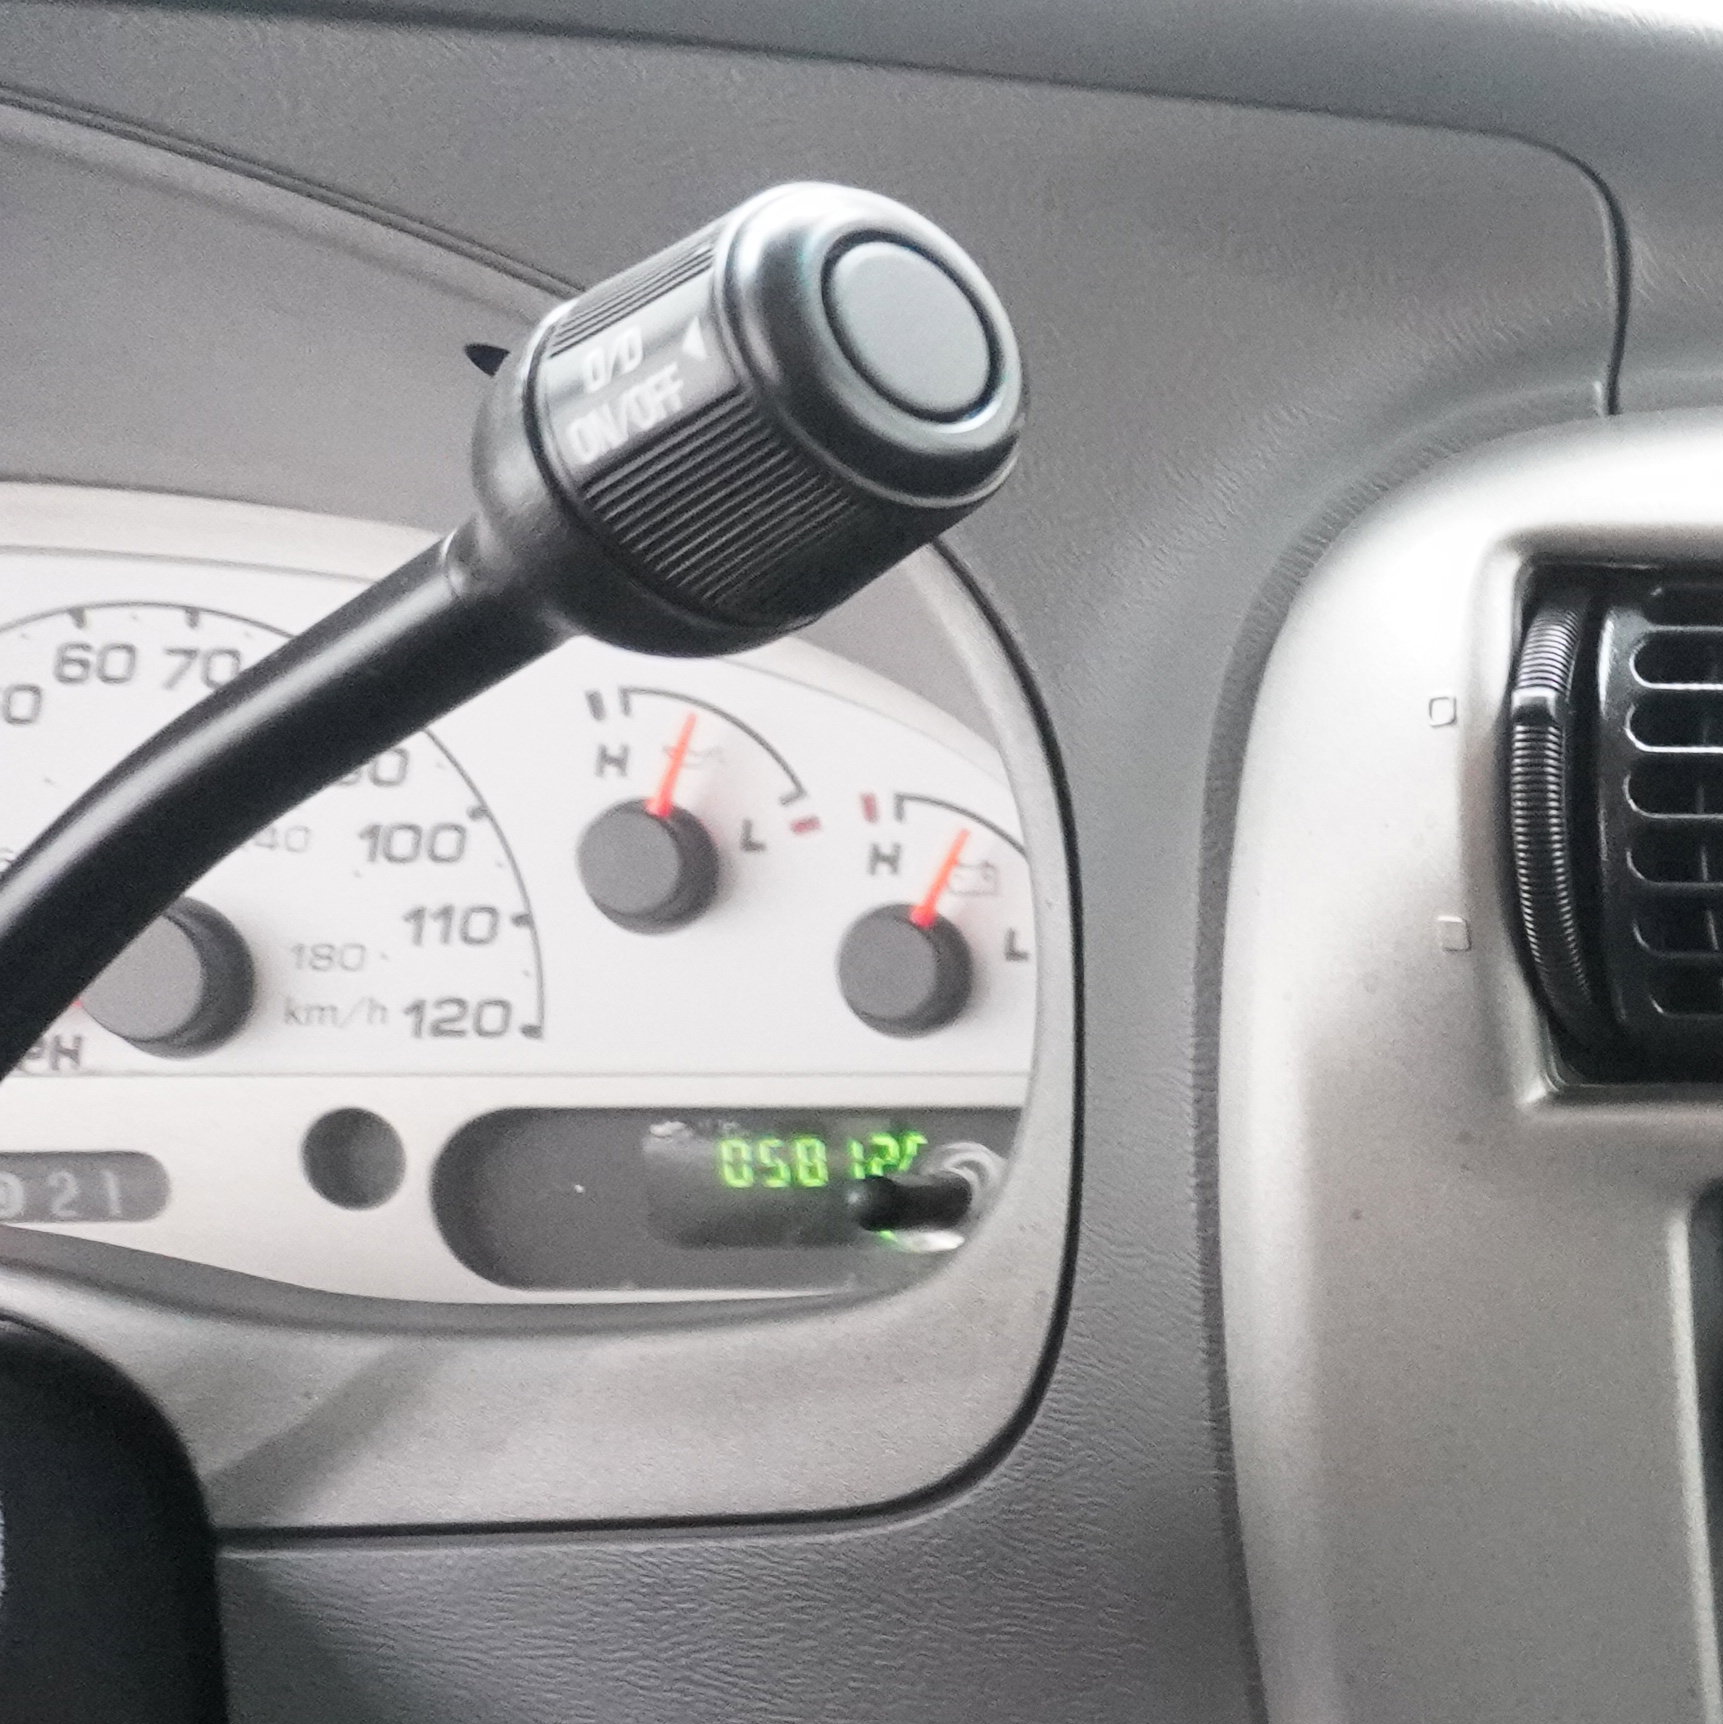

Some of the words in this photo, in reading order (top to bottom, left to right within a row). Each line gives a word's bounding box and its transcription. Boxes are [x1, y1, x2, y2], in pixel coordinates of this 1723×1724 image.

[565, 362, 685, 465] ON/OFF
[54, 642, 137, 685] 60
[162, 647, 241, 691] 70
[2, 684, 43, 726] 0
[595, 744, 630, 778] H
[358, 822, 467, 864] 100
[740, 818, 767, 853] L
[868, 843, 902, 876] H
[402, 904, 500, 946] 110
[1004, 929, 1029, 962] L
[291, 942, 367, 972] 180
[283, 997, 389, 1028] km/h
[402, 997, 513, 1039] 120
[20, 1034, 84, 1072] PH
[48, 1169, 80, 1218] 2
[101, 1168, 124, 1218] 1
